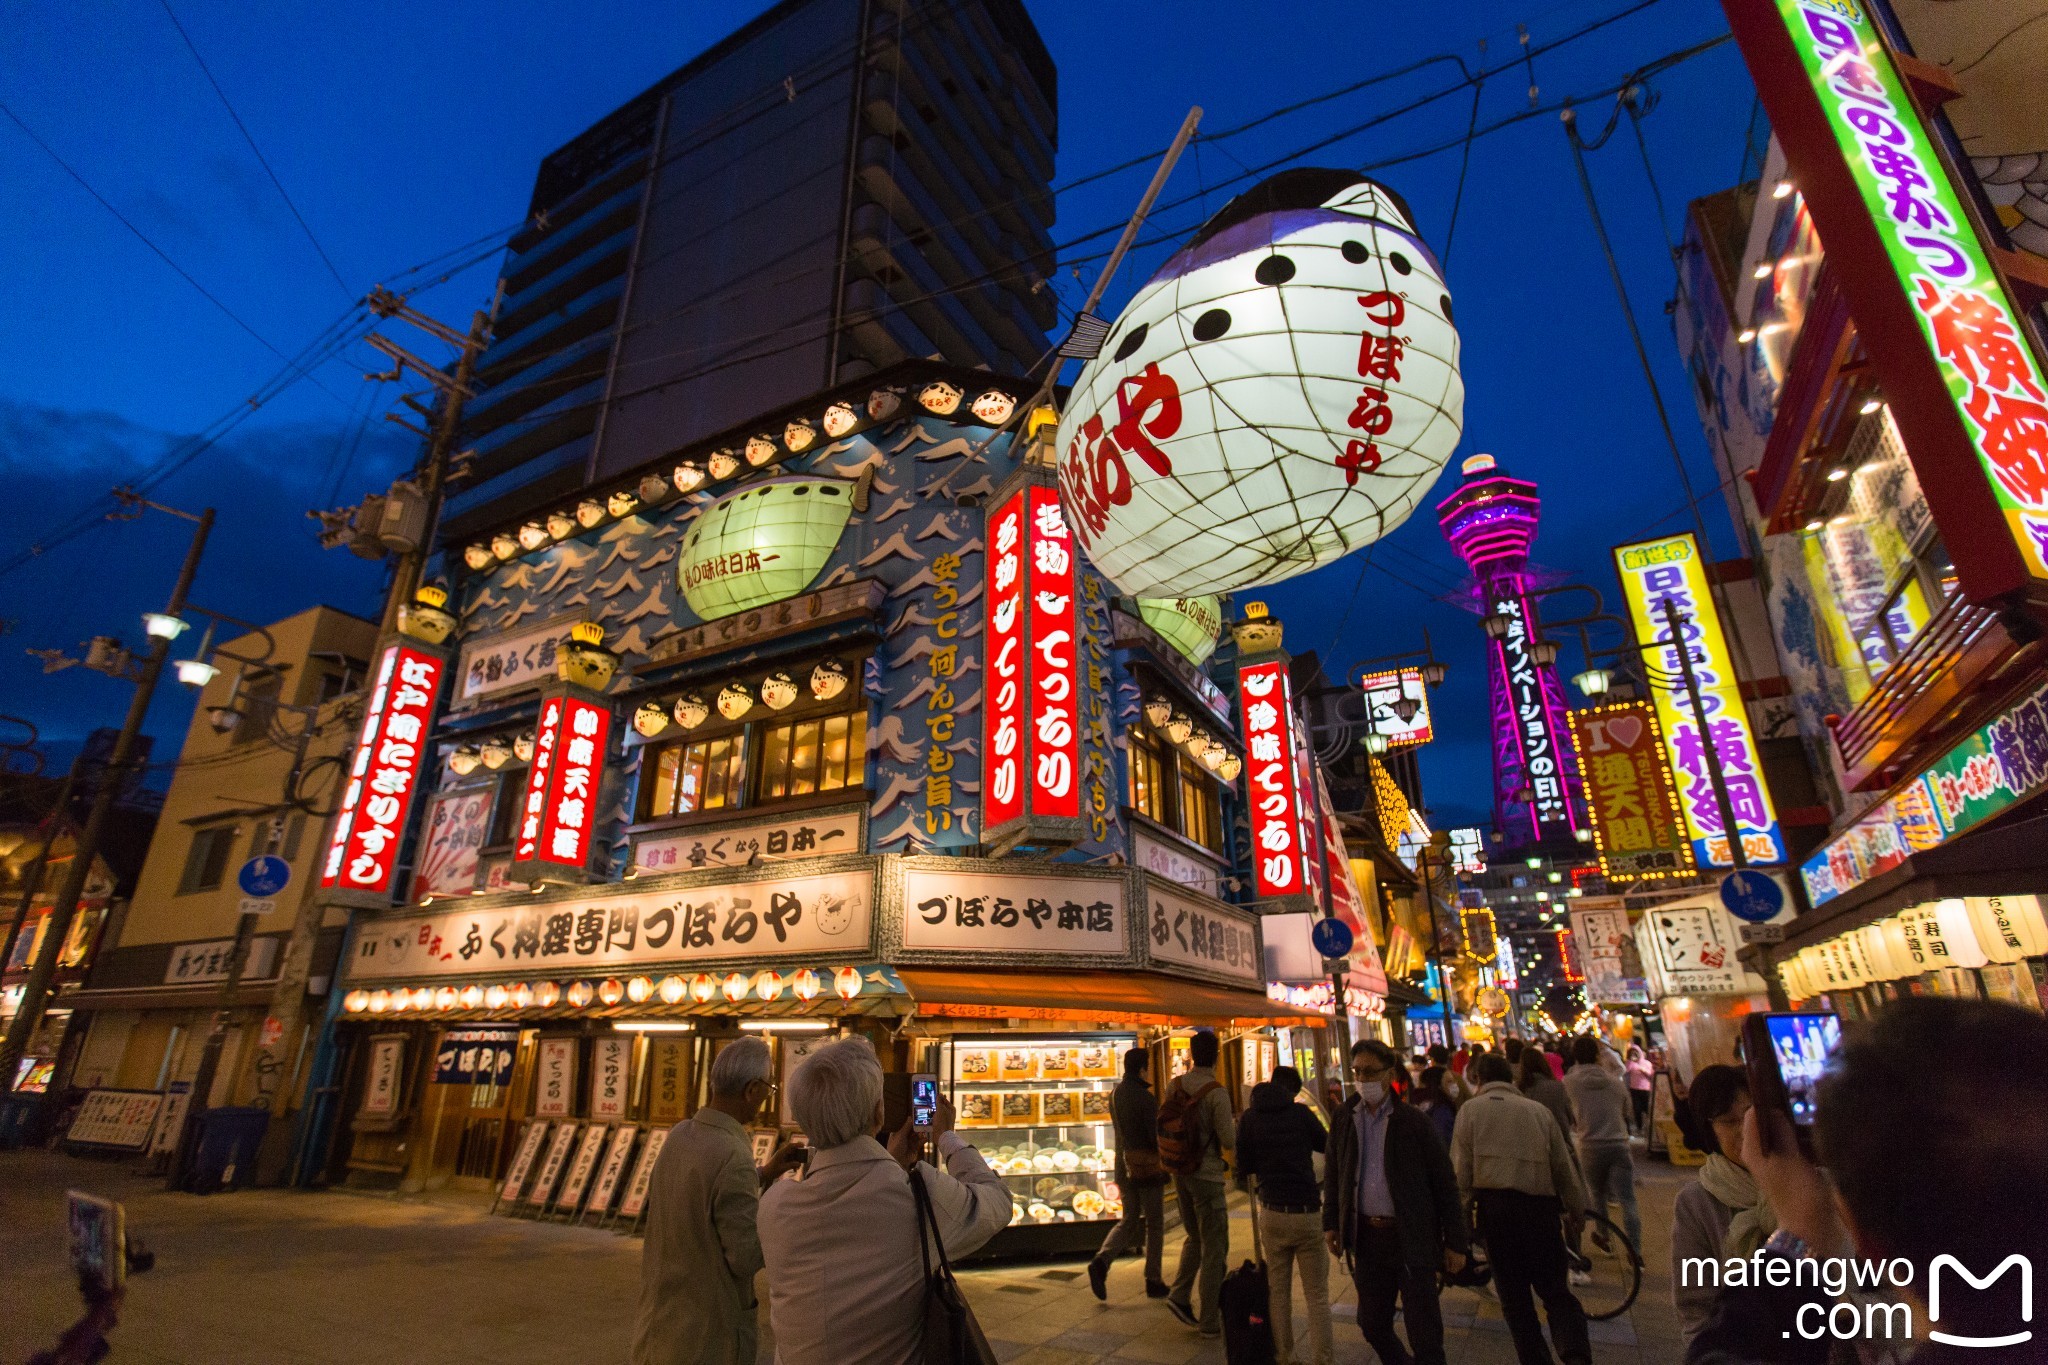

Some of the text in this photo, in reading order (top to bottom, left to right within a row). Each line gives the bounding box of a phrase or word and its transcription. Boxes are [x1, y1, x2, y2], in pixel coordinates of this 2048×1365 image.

[1335, 290, 1412, 486] づぼらや
[685, 549, 781, 590] 私の味は日本一
[1622, 539, 1692, 569] 新世界
[925, 552, 962, 836] 安うて何んでも旨い
[993, 636, 1018, 805] てっちり
[1035, 629, 1072, 798] てっちり
[1247, 699, 1293, 888] 珍味てっちり
[1591, 752, 1653, 853] 通天閣
[1633, 750, 1673, 848] TSUTENKAKU
[1706, 837, 1776, 866] 酒処
[418, 924, 453, 962] 日本一
[917, 894, 1115, 933] づぼらや本店
[1150, 899, 1256, 971] ふぐ料理専門
